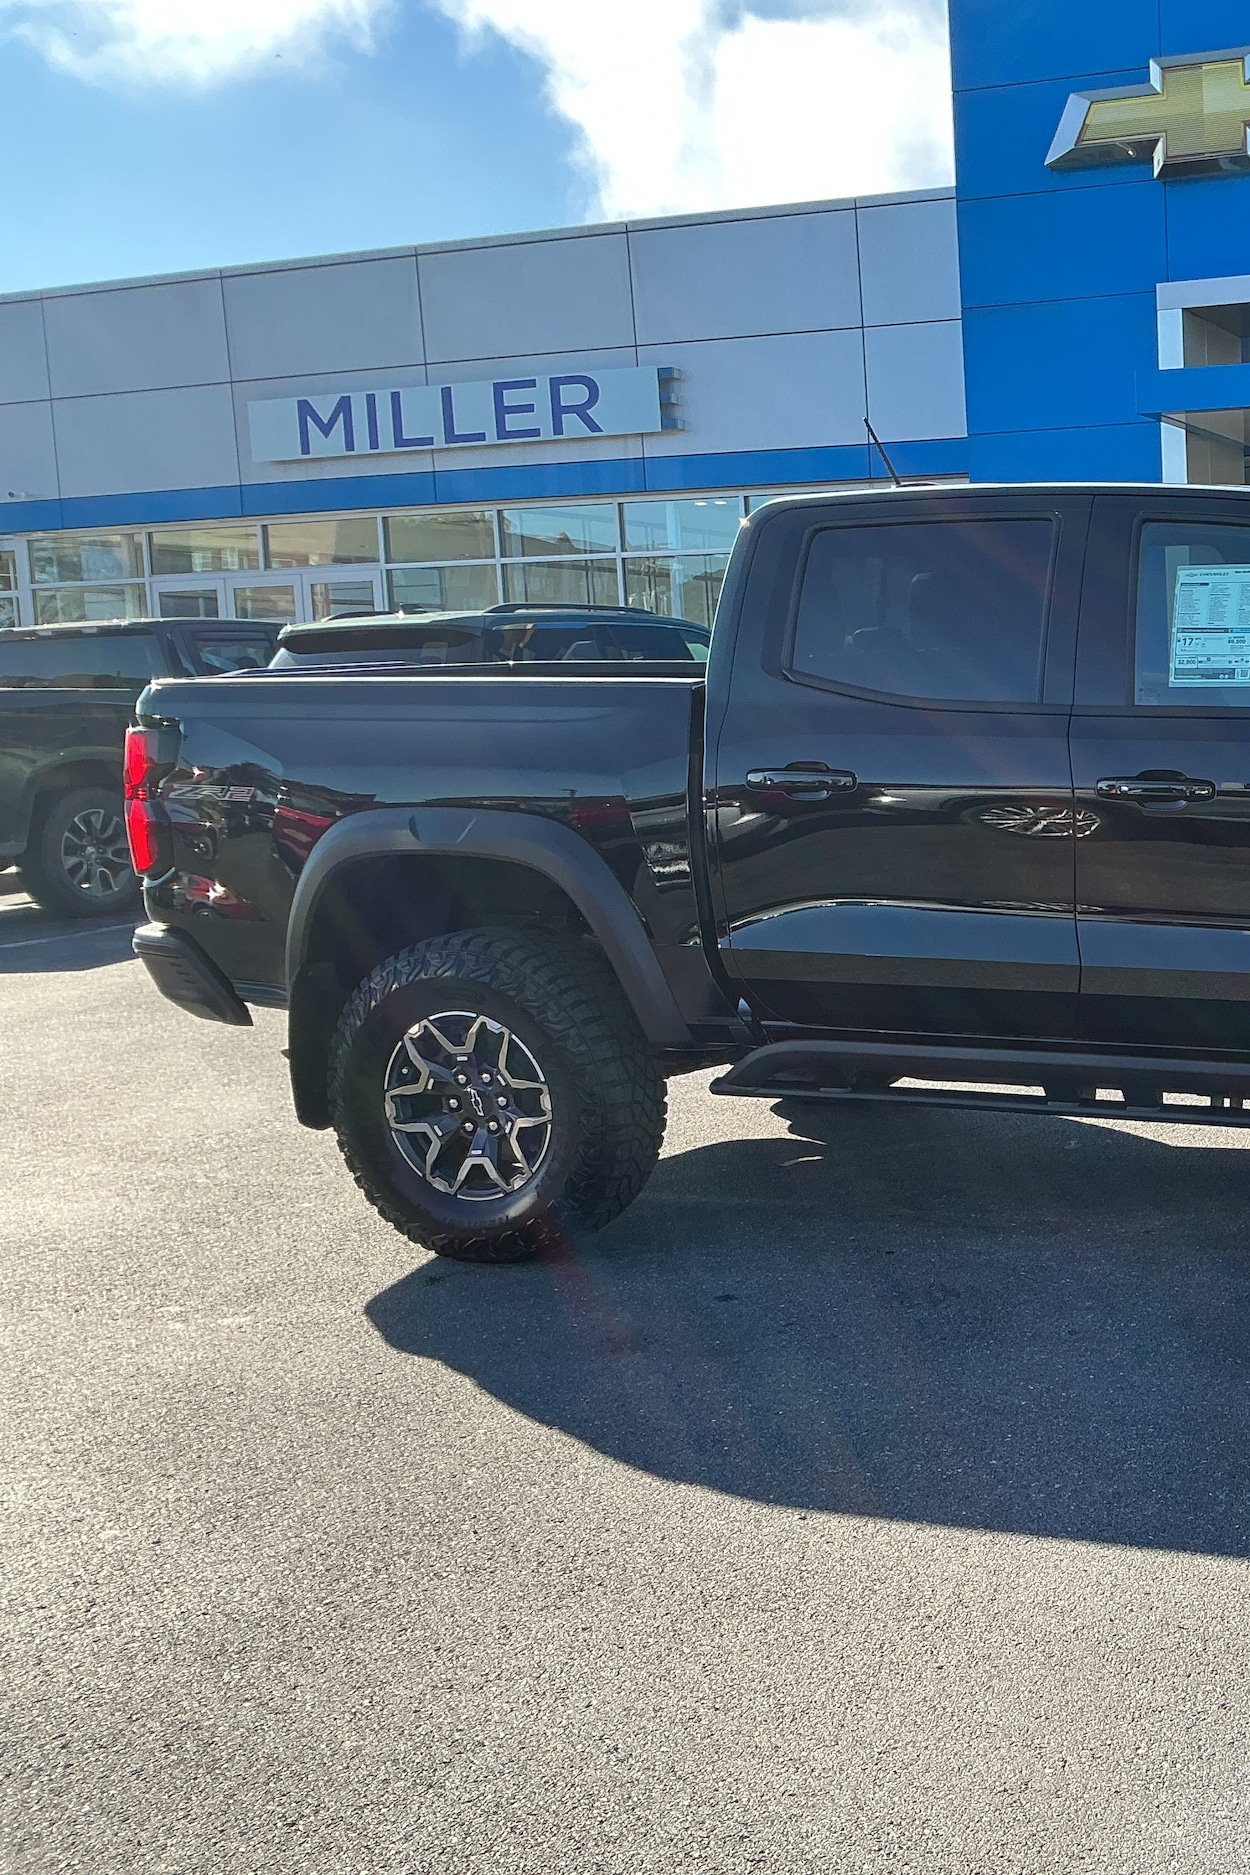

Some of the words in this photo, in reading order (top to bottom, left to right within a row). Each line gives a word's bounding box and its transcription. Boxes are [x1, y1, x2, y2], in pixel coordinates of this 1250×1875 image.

[296, 374, 604, 456] MILLER
[1182, 637, 1194, 646] 17
[168, 784, 255, 802] ZR2
